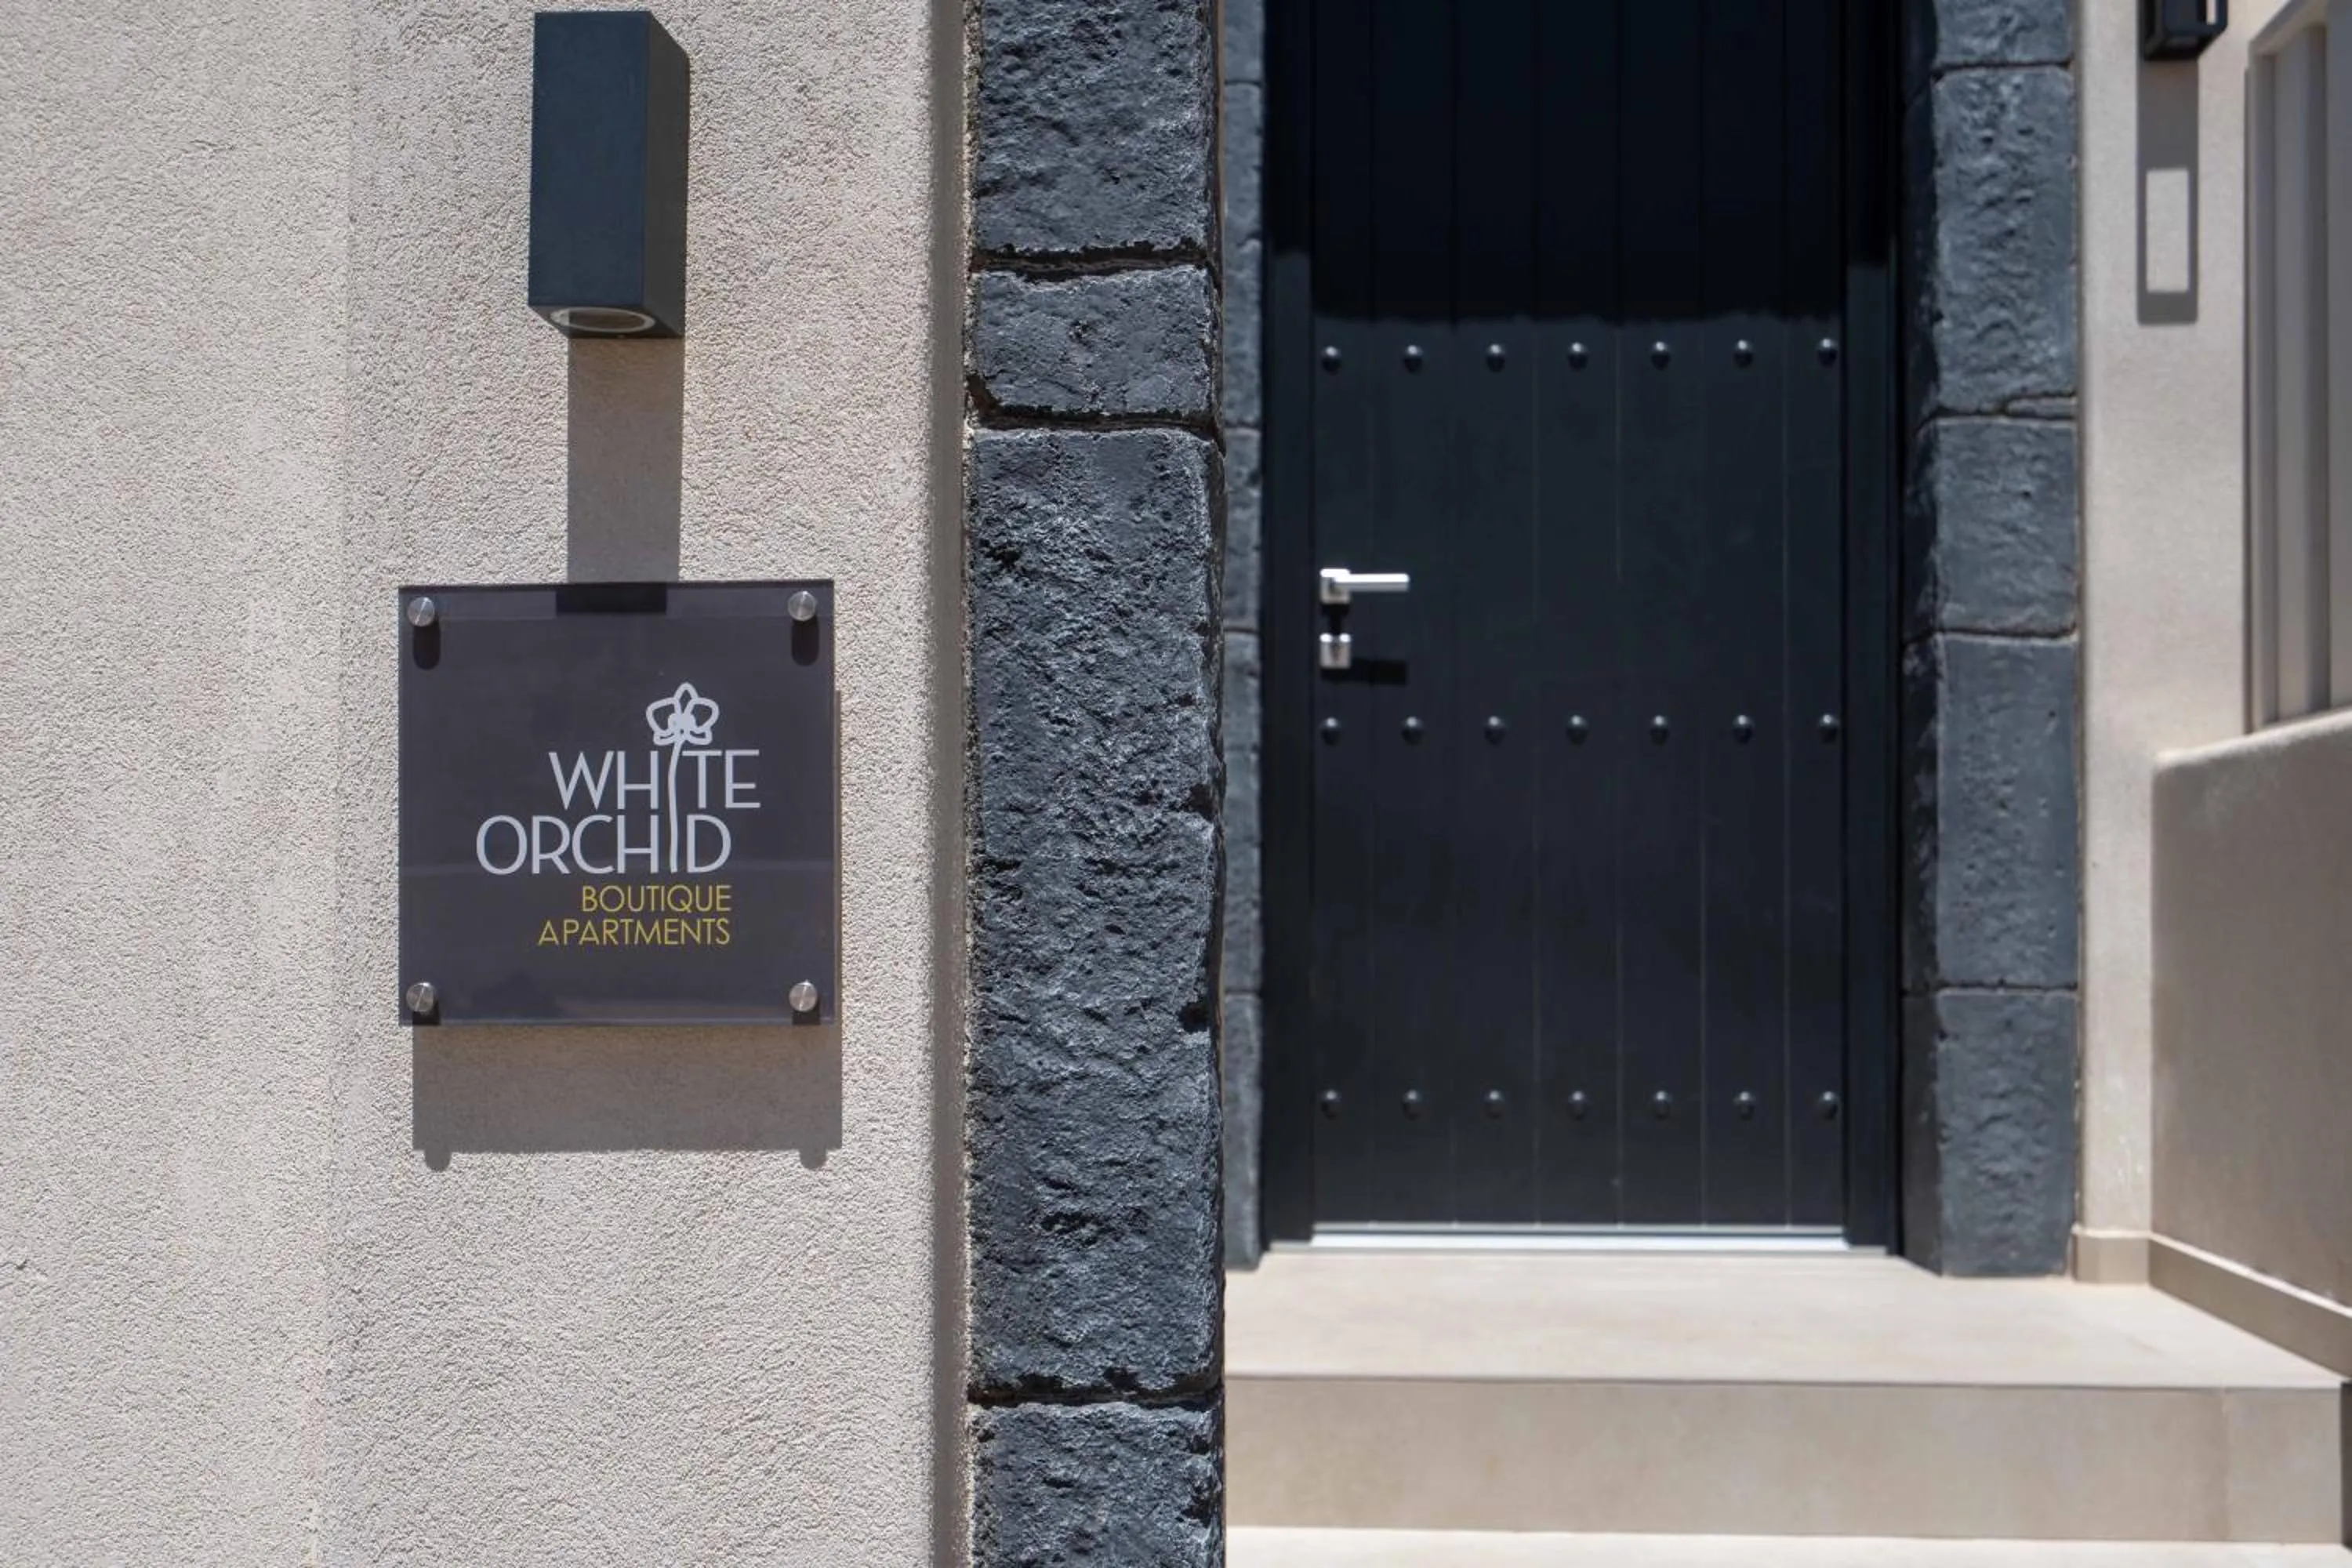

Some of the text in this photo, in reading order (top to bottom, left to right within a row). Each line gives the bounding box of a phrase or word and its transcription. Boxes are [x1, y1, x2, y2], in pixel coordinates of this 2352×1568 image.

[549, 749, 761, 810] WHITE
[476, 814, 732, 875] ORCHID
[581, 884, 732, 913] BOUTIQUE
[538, 918, 731, 946] APARTMENTS
